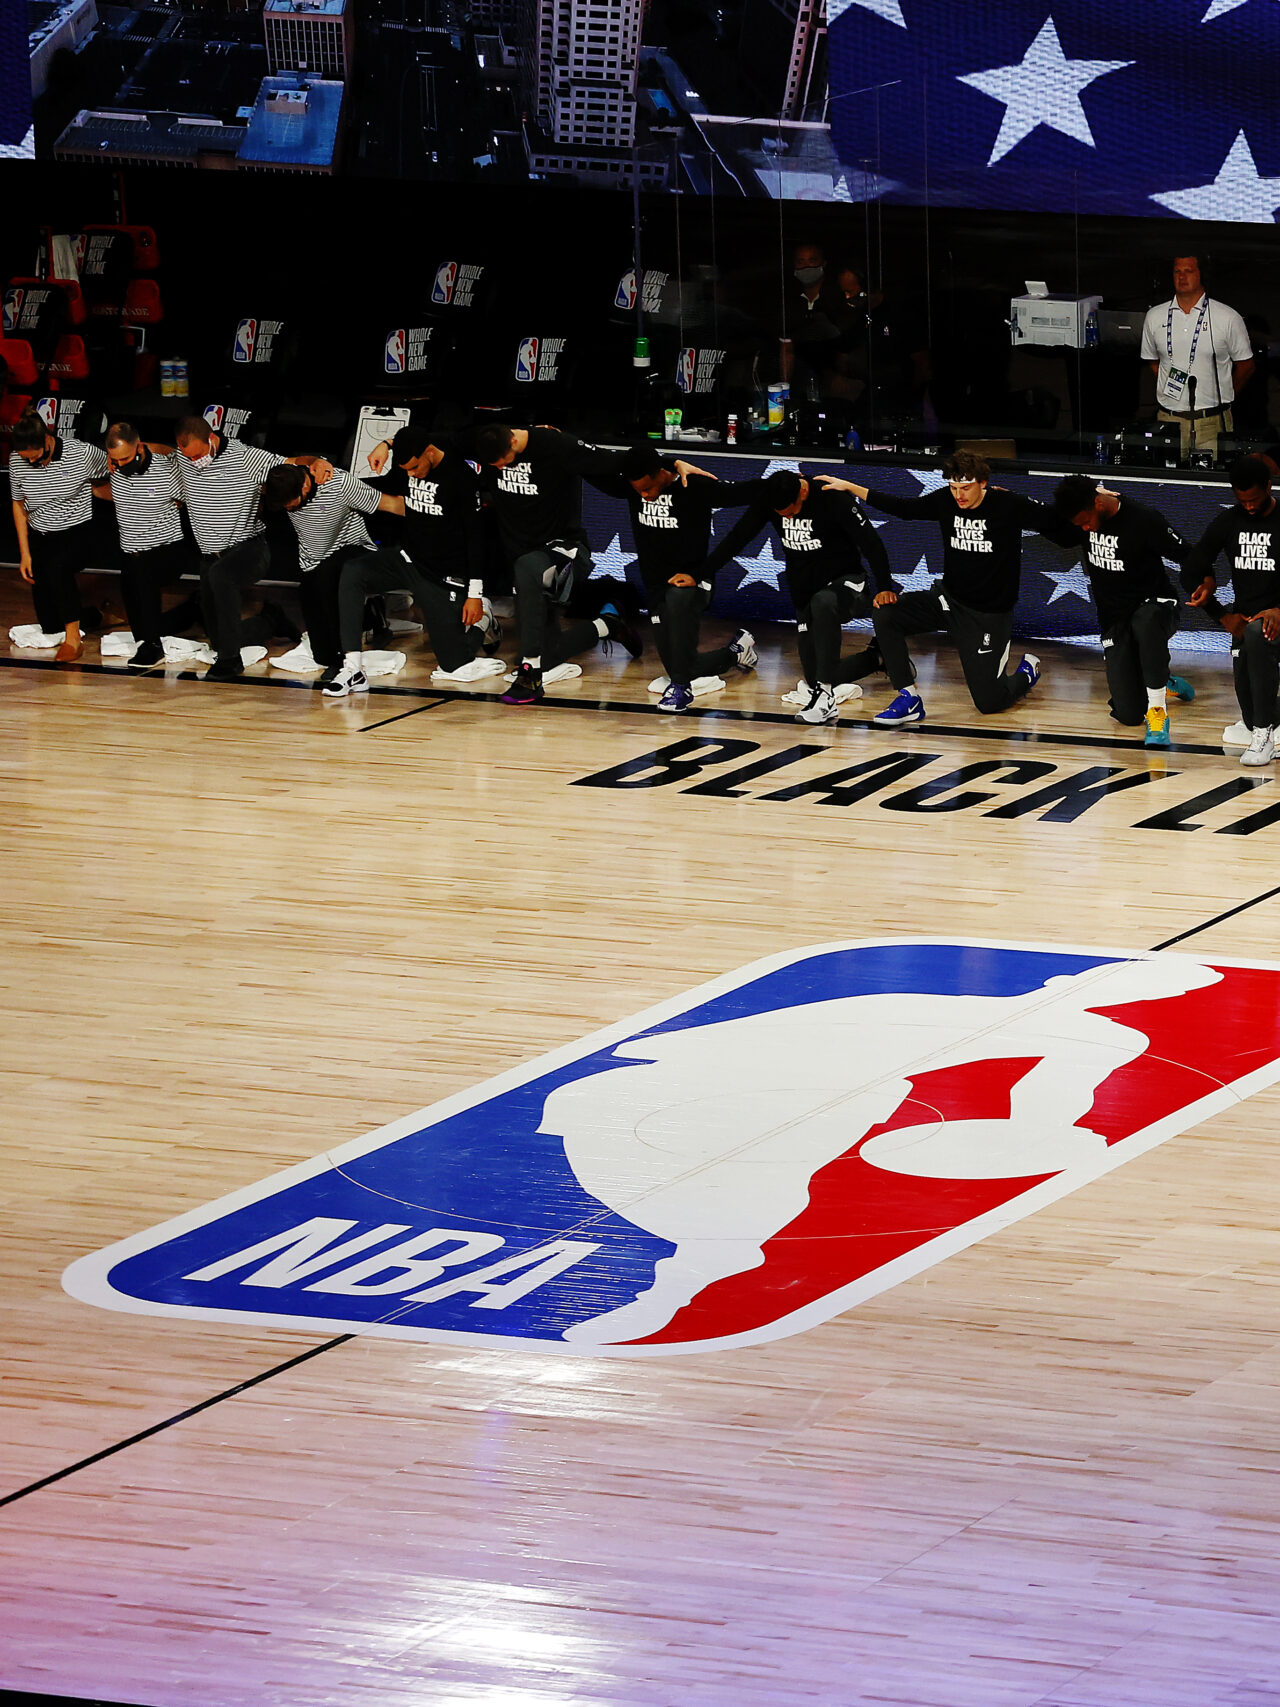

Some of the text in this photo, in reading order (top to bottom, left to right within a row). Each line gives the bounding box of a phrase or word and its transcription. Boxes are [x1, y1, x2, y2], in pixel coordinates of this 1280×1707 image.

[408, 327, 434, 343] WHOLE
[407, 341, 425, 357] NEW
[541, 338, 567, 353] WHOLE
[539, 352, 557, 367] NEW
[60, 399, 86, 414] WHOLE
[57, 413, 75, 429] NEW
[225, 407, 252, 424] WHOLE
[222, 422, 241, 439] NEW
[502, 469, 530, 484] LIVES
[408, 476, 440, 494] BLACK
[497, 478, 539, 495] MATTER
[409, 487, 435, 504] LIVES
[404, 496, 444, 516] MATTER
[642, 502, 670, 517] LIVES
[638, 511, 679, 529] MATTER
[781, 516, 814, 532] BLACK
[953, 515, 988, 531] BLACK
[784, 529, 812, 542] LIVES
[955, 528, 985, 541] LIVES
[1088, 531, 1119, 549] BLACK
[1238, 531, 1272, 546] BLACK
[781, 537, 823, 552] MATTER
[950, 537, 994, 553] MATTER
[1090, 545, 1117, 560] LIVES
[1240, 545, 1268, 558] LIVES
[1087, 552, 1125, 572] MATTER
[1234, 557, 1276, 572] MATTER
[567, 736, 1182, 823] BLACK
[181, 1216, 602, 1311] NBA
